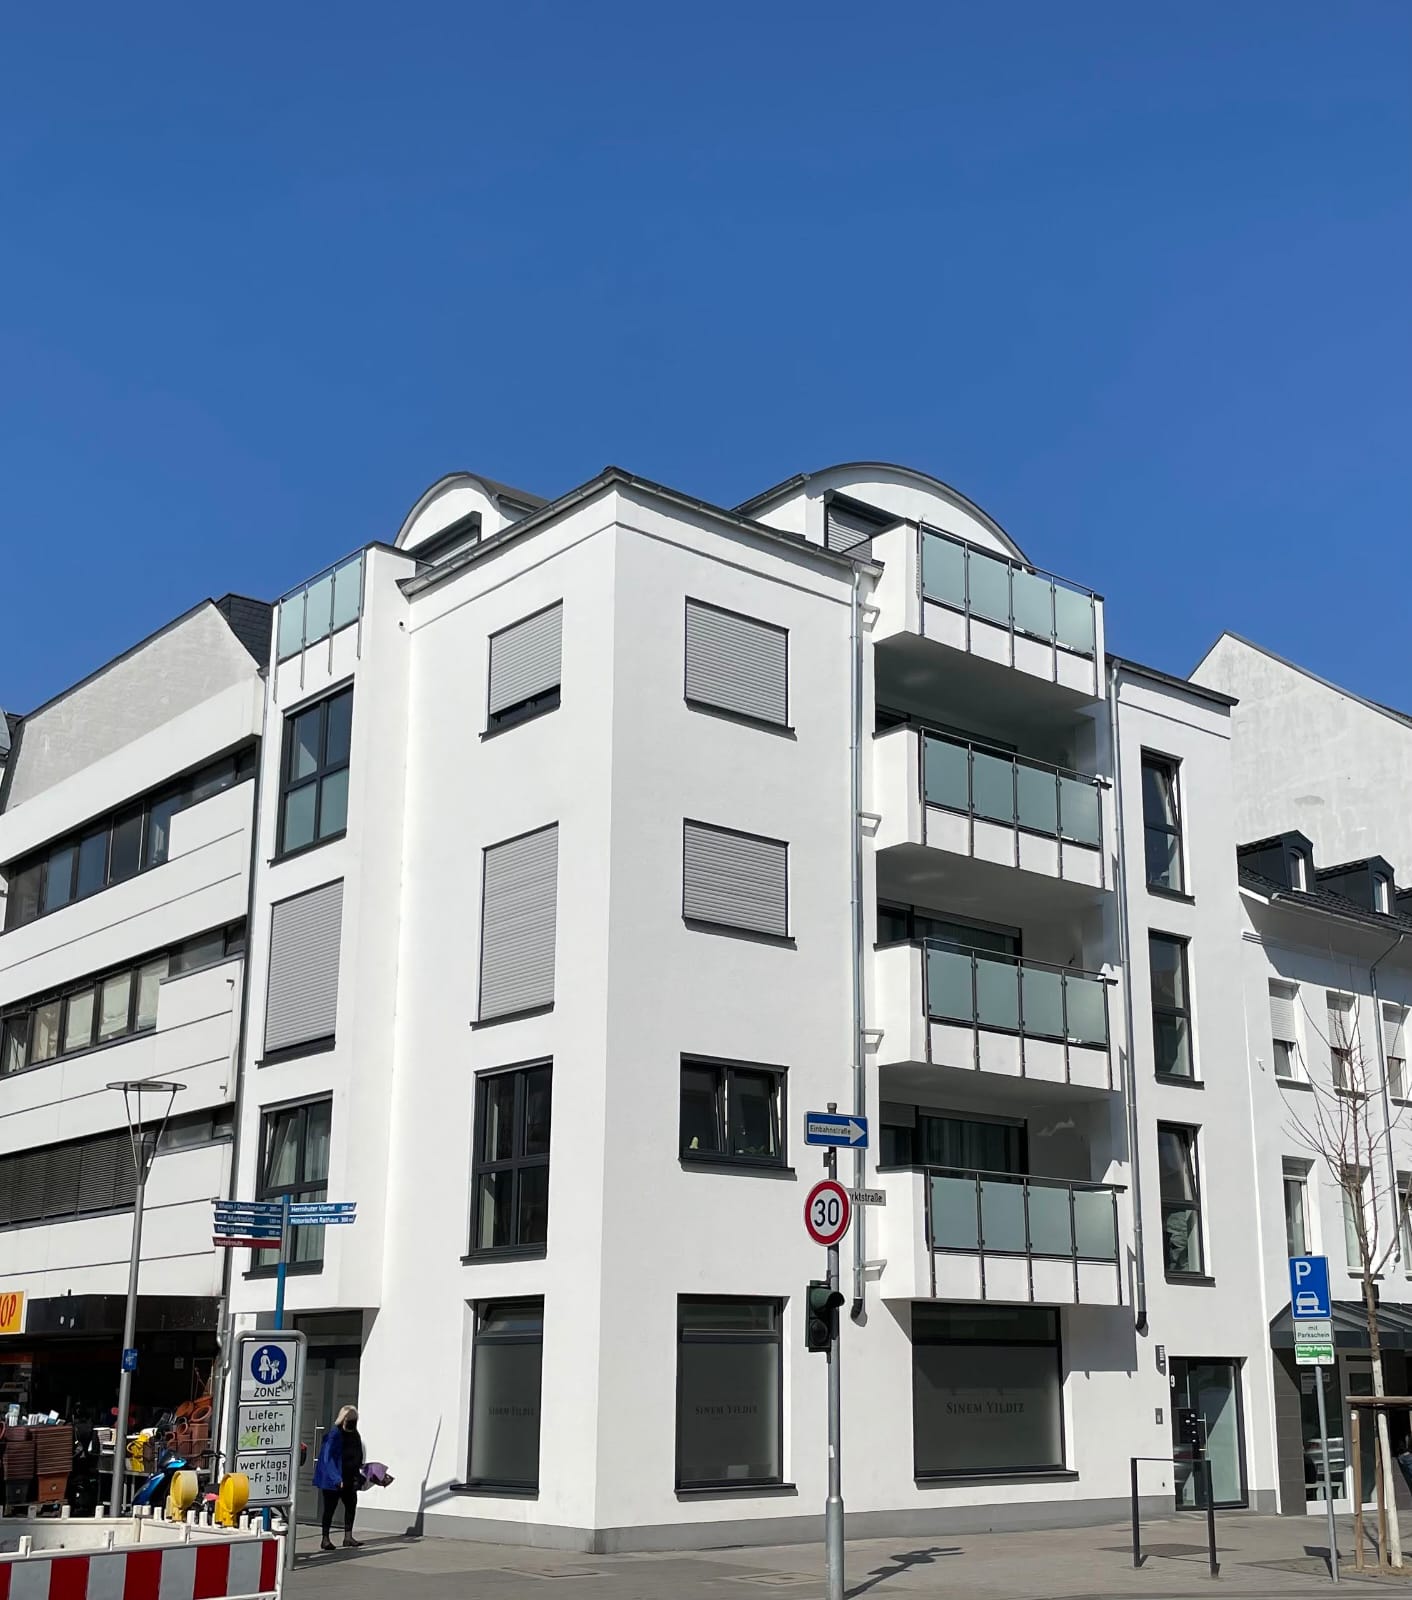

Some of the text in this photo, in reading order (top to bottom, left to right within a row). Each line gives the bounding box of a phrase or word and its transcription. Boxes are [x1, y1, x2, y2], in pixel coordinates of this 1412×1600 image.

[810, 1124, 851, 1135] Einbahnstraße
[849, 1191, 883, 1203] rktstraße
[814, 1198, 840, 1227] 30
[1295, 1261, 1312, 1285] P
[253, 1387, 281, 1398] ZONE
[248, 1410, 284, 1420] Liefer-
[245, 1421, 286, 1433] verkehr
[256, 1435, 274, 1446] frei
[240, 1460, 287, 1471] werktags
[266, 1472, 287, 1482] 5-11h
[265, 1484, 287, 1495] 5-10h
